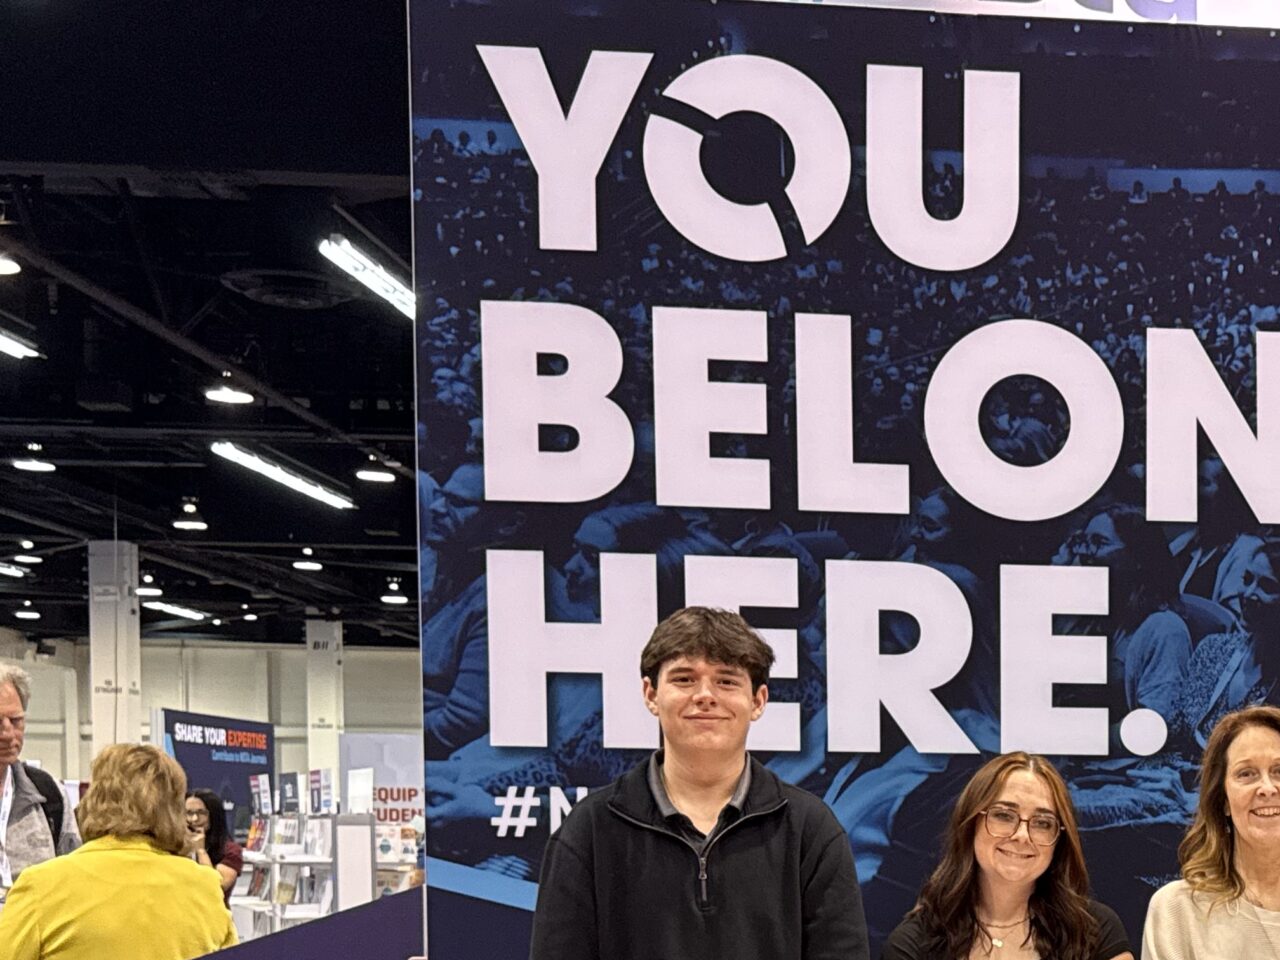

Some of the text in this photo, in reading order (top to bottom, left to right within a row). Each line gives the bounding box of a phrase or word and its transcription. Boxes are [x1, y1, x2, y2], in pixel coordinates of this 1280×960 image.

[475, 44, 1020, 271] YOU
[174, 722, 268, 750] SHARE YOUR EXPERTISE
[485, 549, 1168, 757] HERE.
